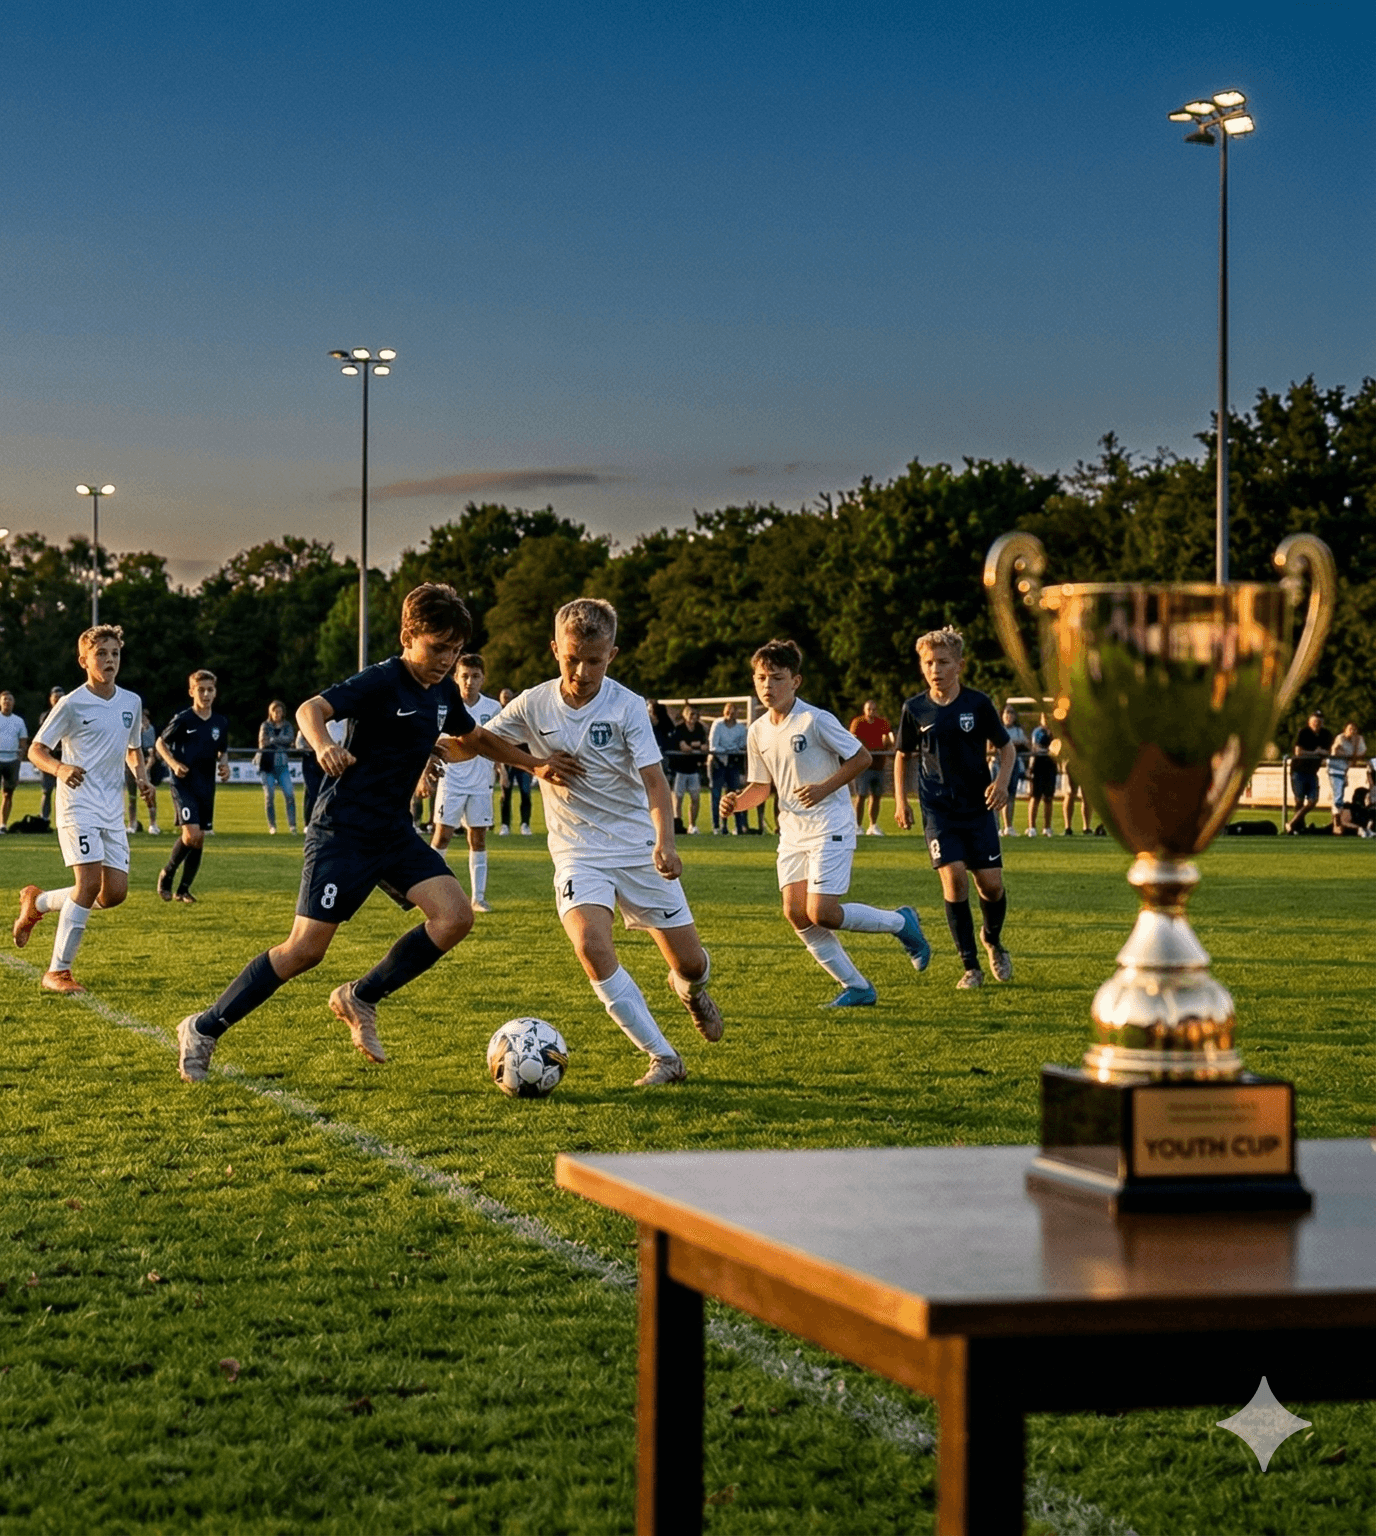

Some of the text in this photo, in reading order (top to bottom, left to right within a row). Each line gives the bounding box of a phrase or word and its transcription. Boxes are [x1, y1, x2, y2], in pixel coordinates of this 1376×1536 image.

[182, 807, 190, 821] 0
[79, 835, 90, 855] 5
[321, 883, 338, 909] 8
[1144, 1135, 1282, 1160] YOUTH CUP
